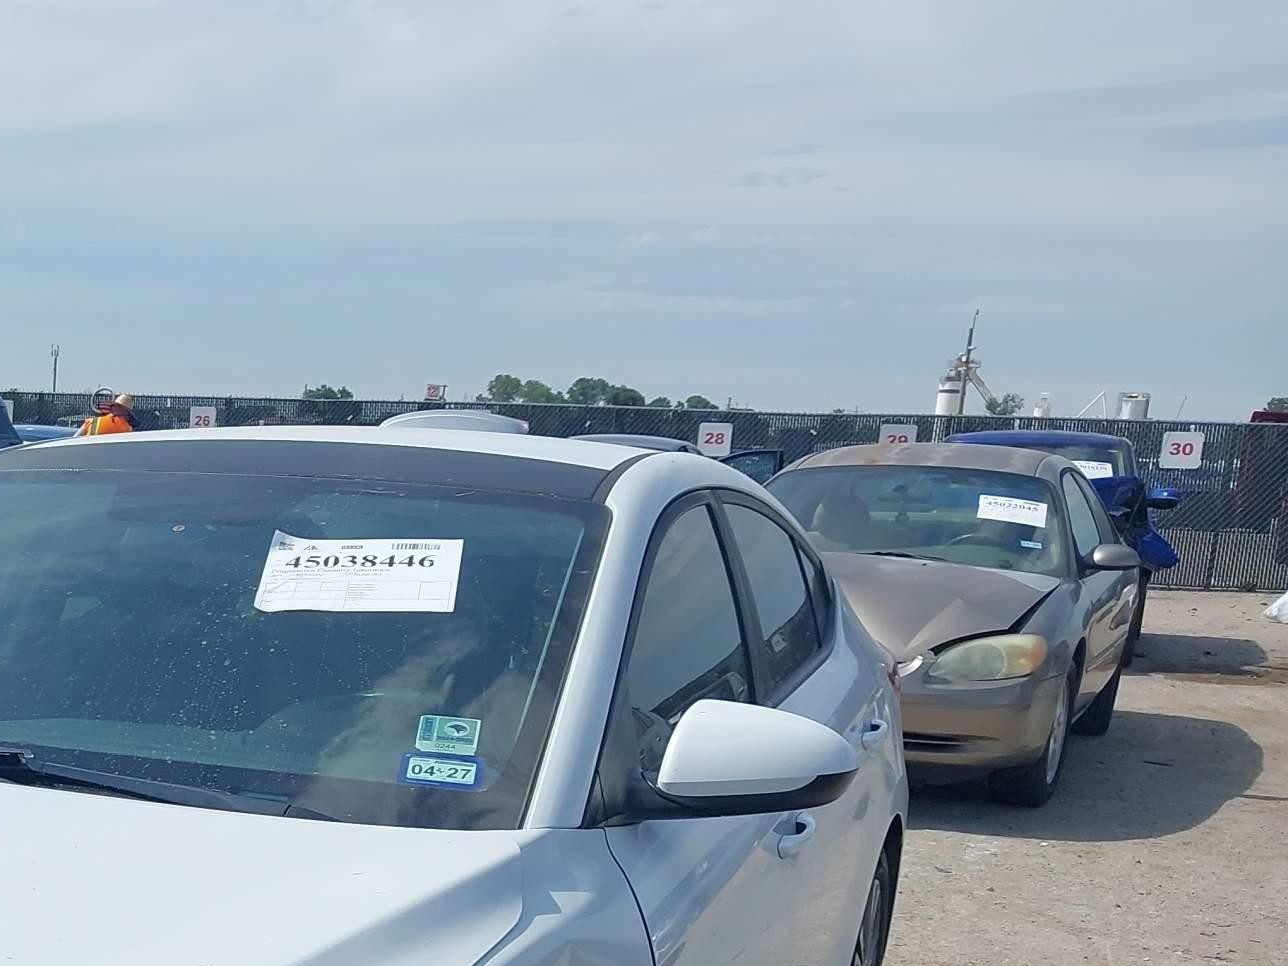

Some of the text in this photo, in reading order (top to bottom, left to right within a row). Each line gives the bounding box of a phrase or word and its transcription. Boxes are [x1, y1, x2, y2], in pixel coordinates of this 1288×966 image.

[194, 415, 211, 426] 26
[703, 432, 726, 445] 28
[1168, 442, 1194, 456] 30
[285, 554, 438, 569] 45038446
